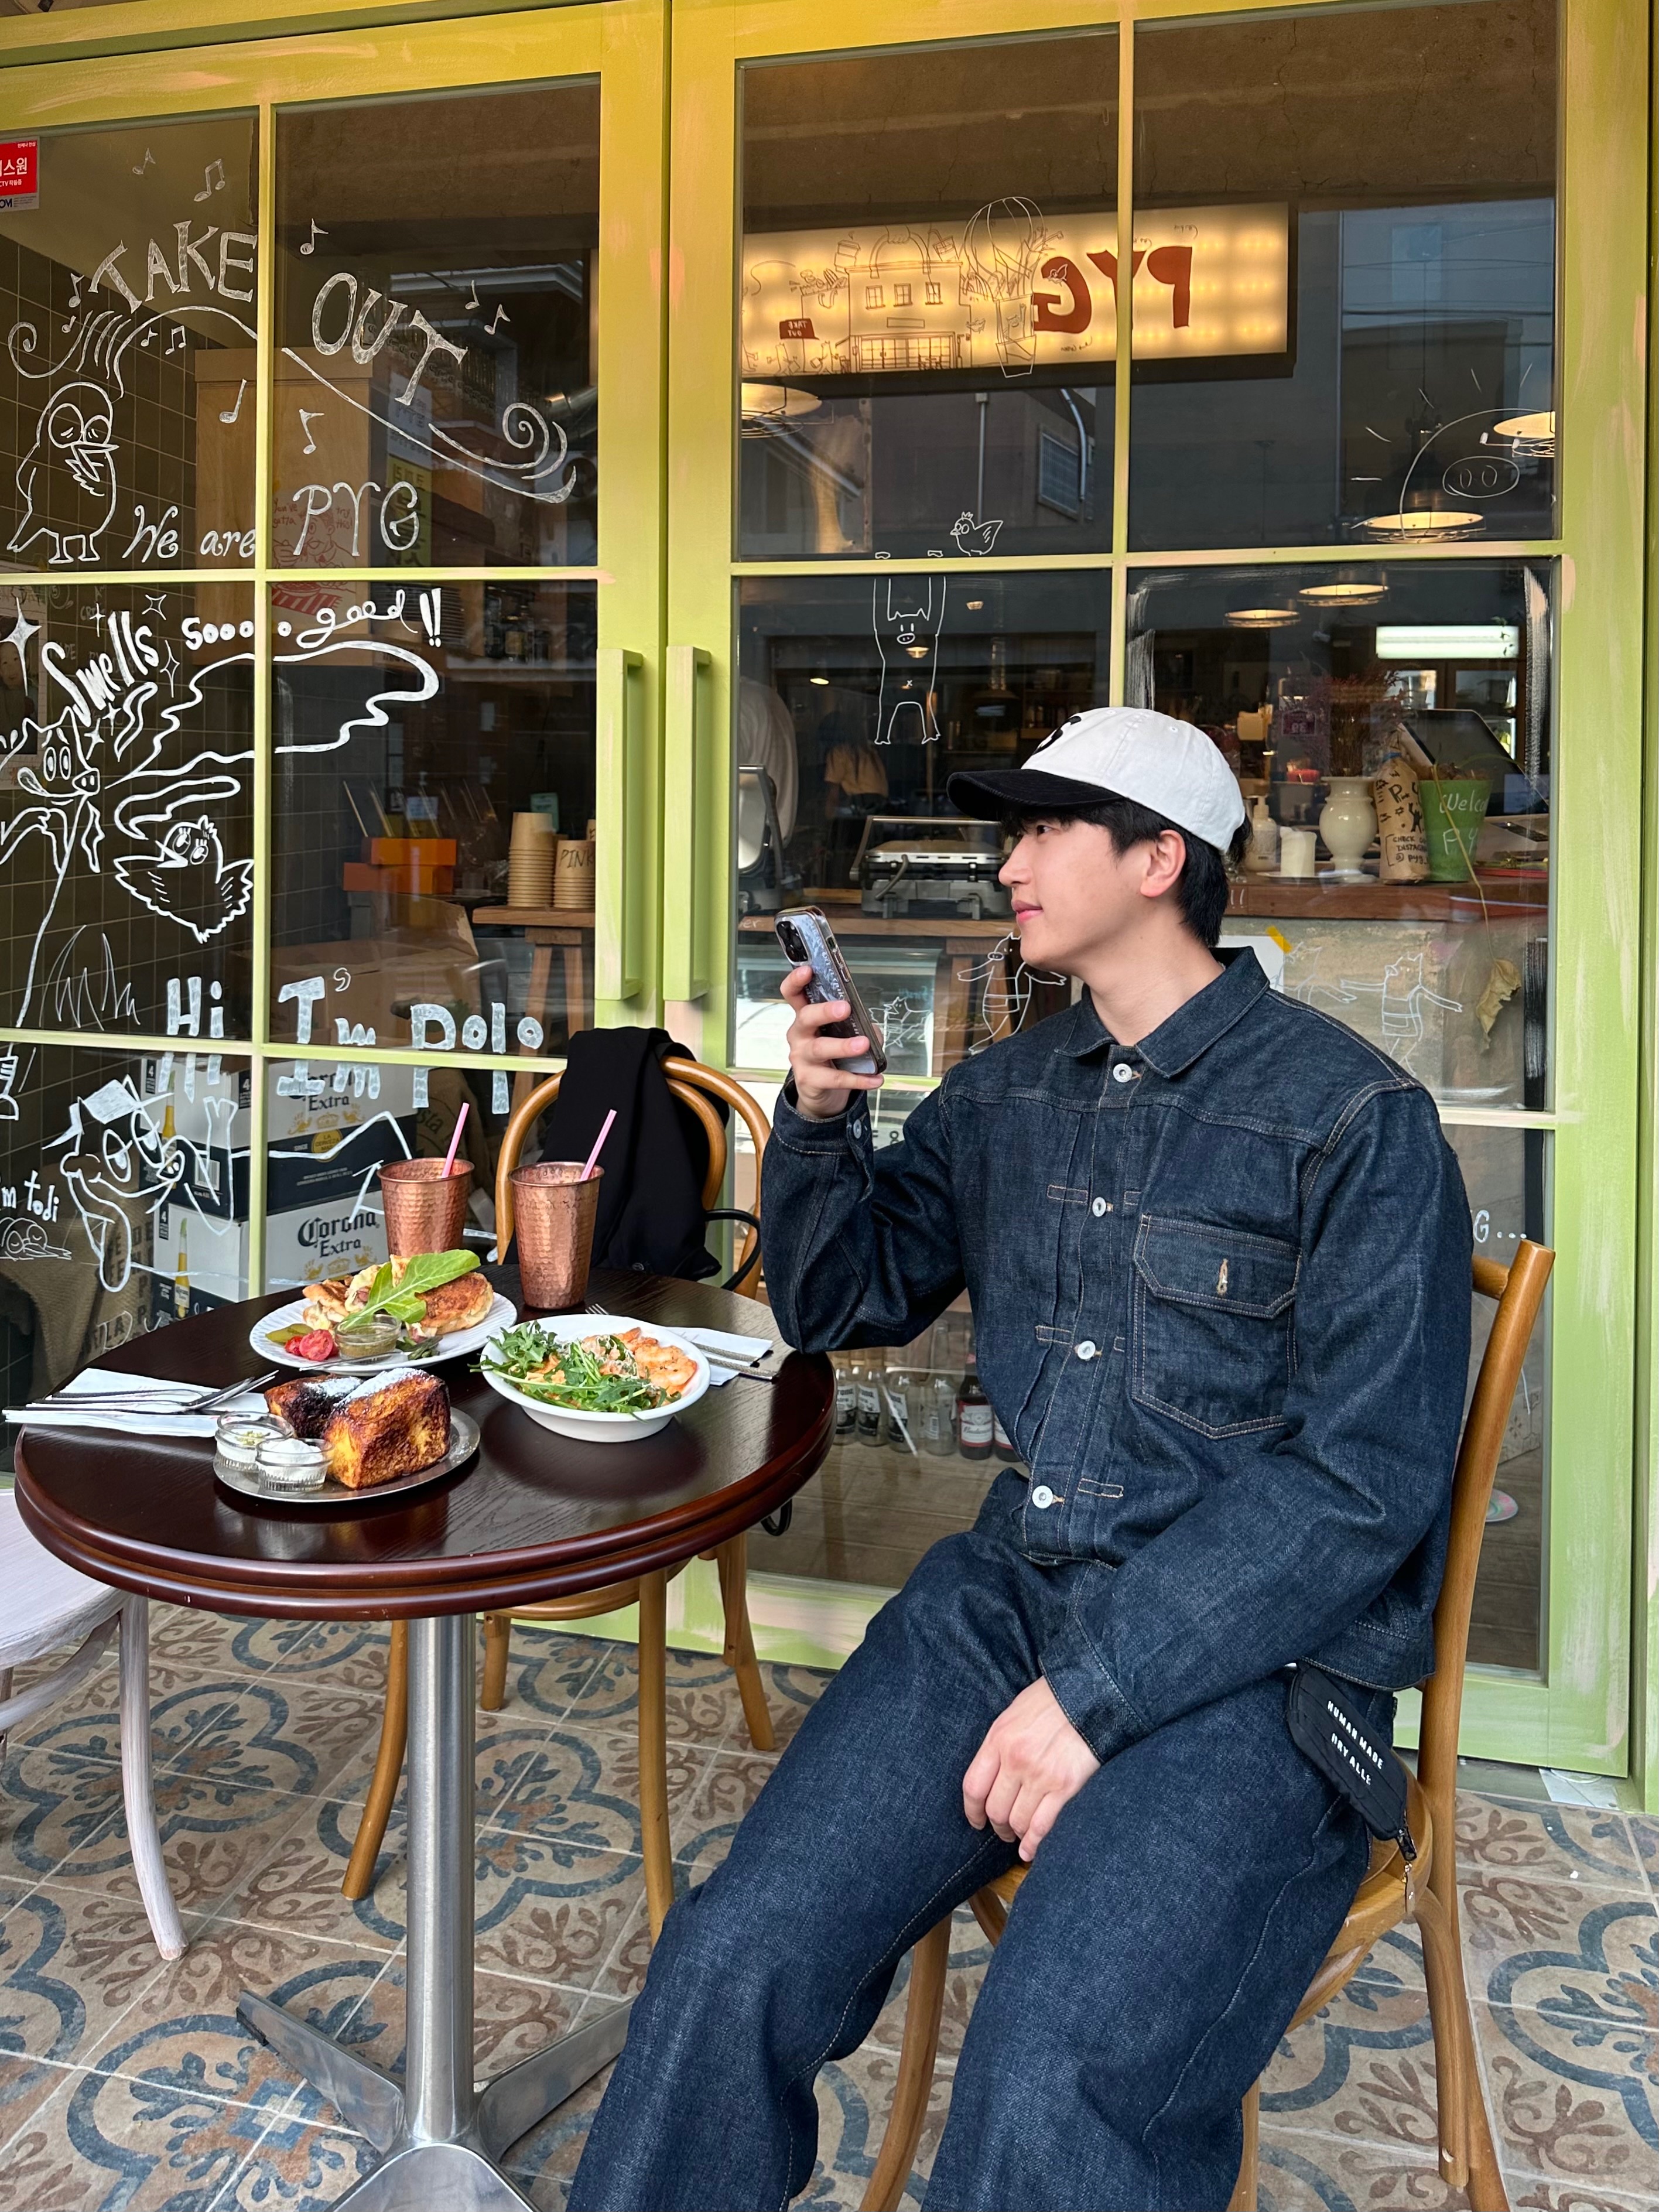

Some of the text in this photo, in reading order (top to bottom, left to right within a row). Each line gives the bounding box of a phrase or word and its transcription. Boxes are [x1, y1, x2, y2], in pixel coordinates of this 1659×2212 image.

[88, 220, 468, 405] TAKE OUT
[122, 505, 179, 560] We
[200, 529, 255, 559] are
[293, 481, 419, 557] PYG
[42, 611, 159, 727] Smells
[158, 976, 224, 1103] Hi
[411, 1002, 543, 1114] Polo
[148, 1065, 153, 1077] 4
[242, 1079, 250, 1090] 4
[309, 1095, 350, 1112] Extra
[23, 1170, 60, 1223] todi
[160, 1211, 166, 1222] 4
[297, 1211, 375, 1248] Corona
[317, 1239, 362, 1259] Extra
[1327, 1700, 1384, 1770] HUMAN MADE
